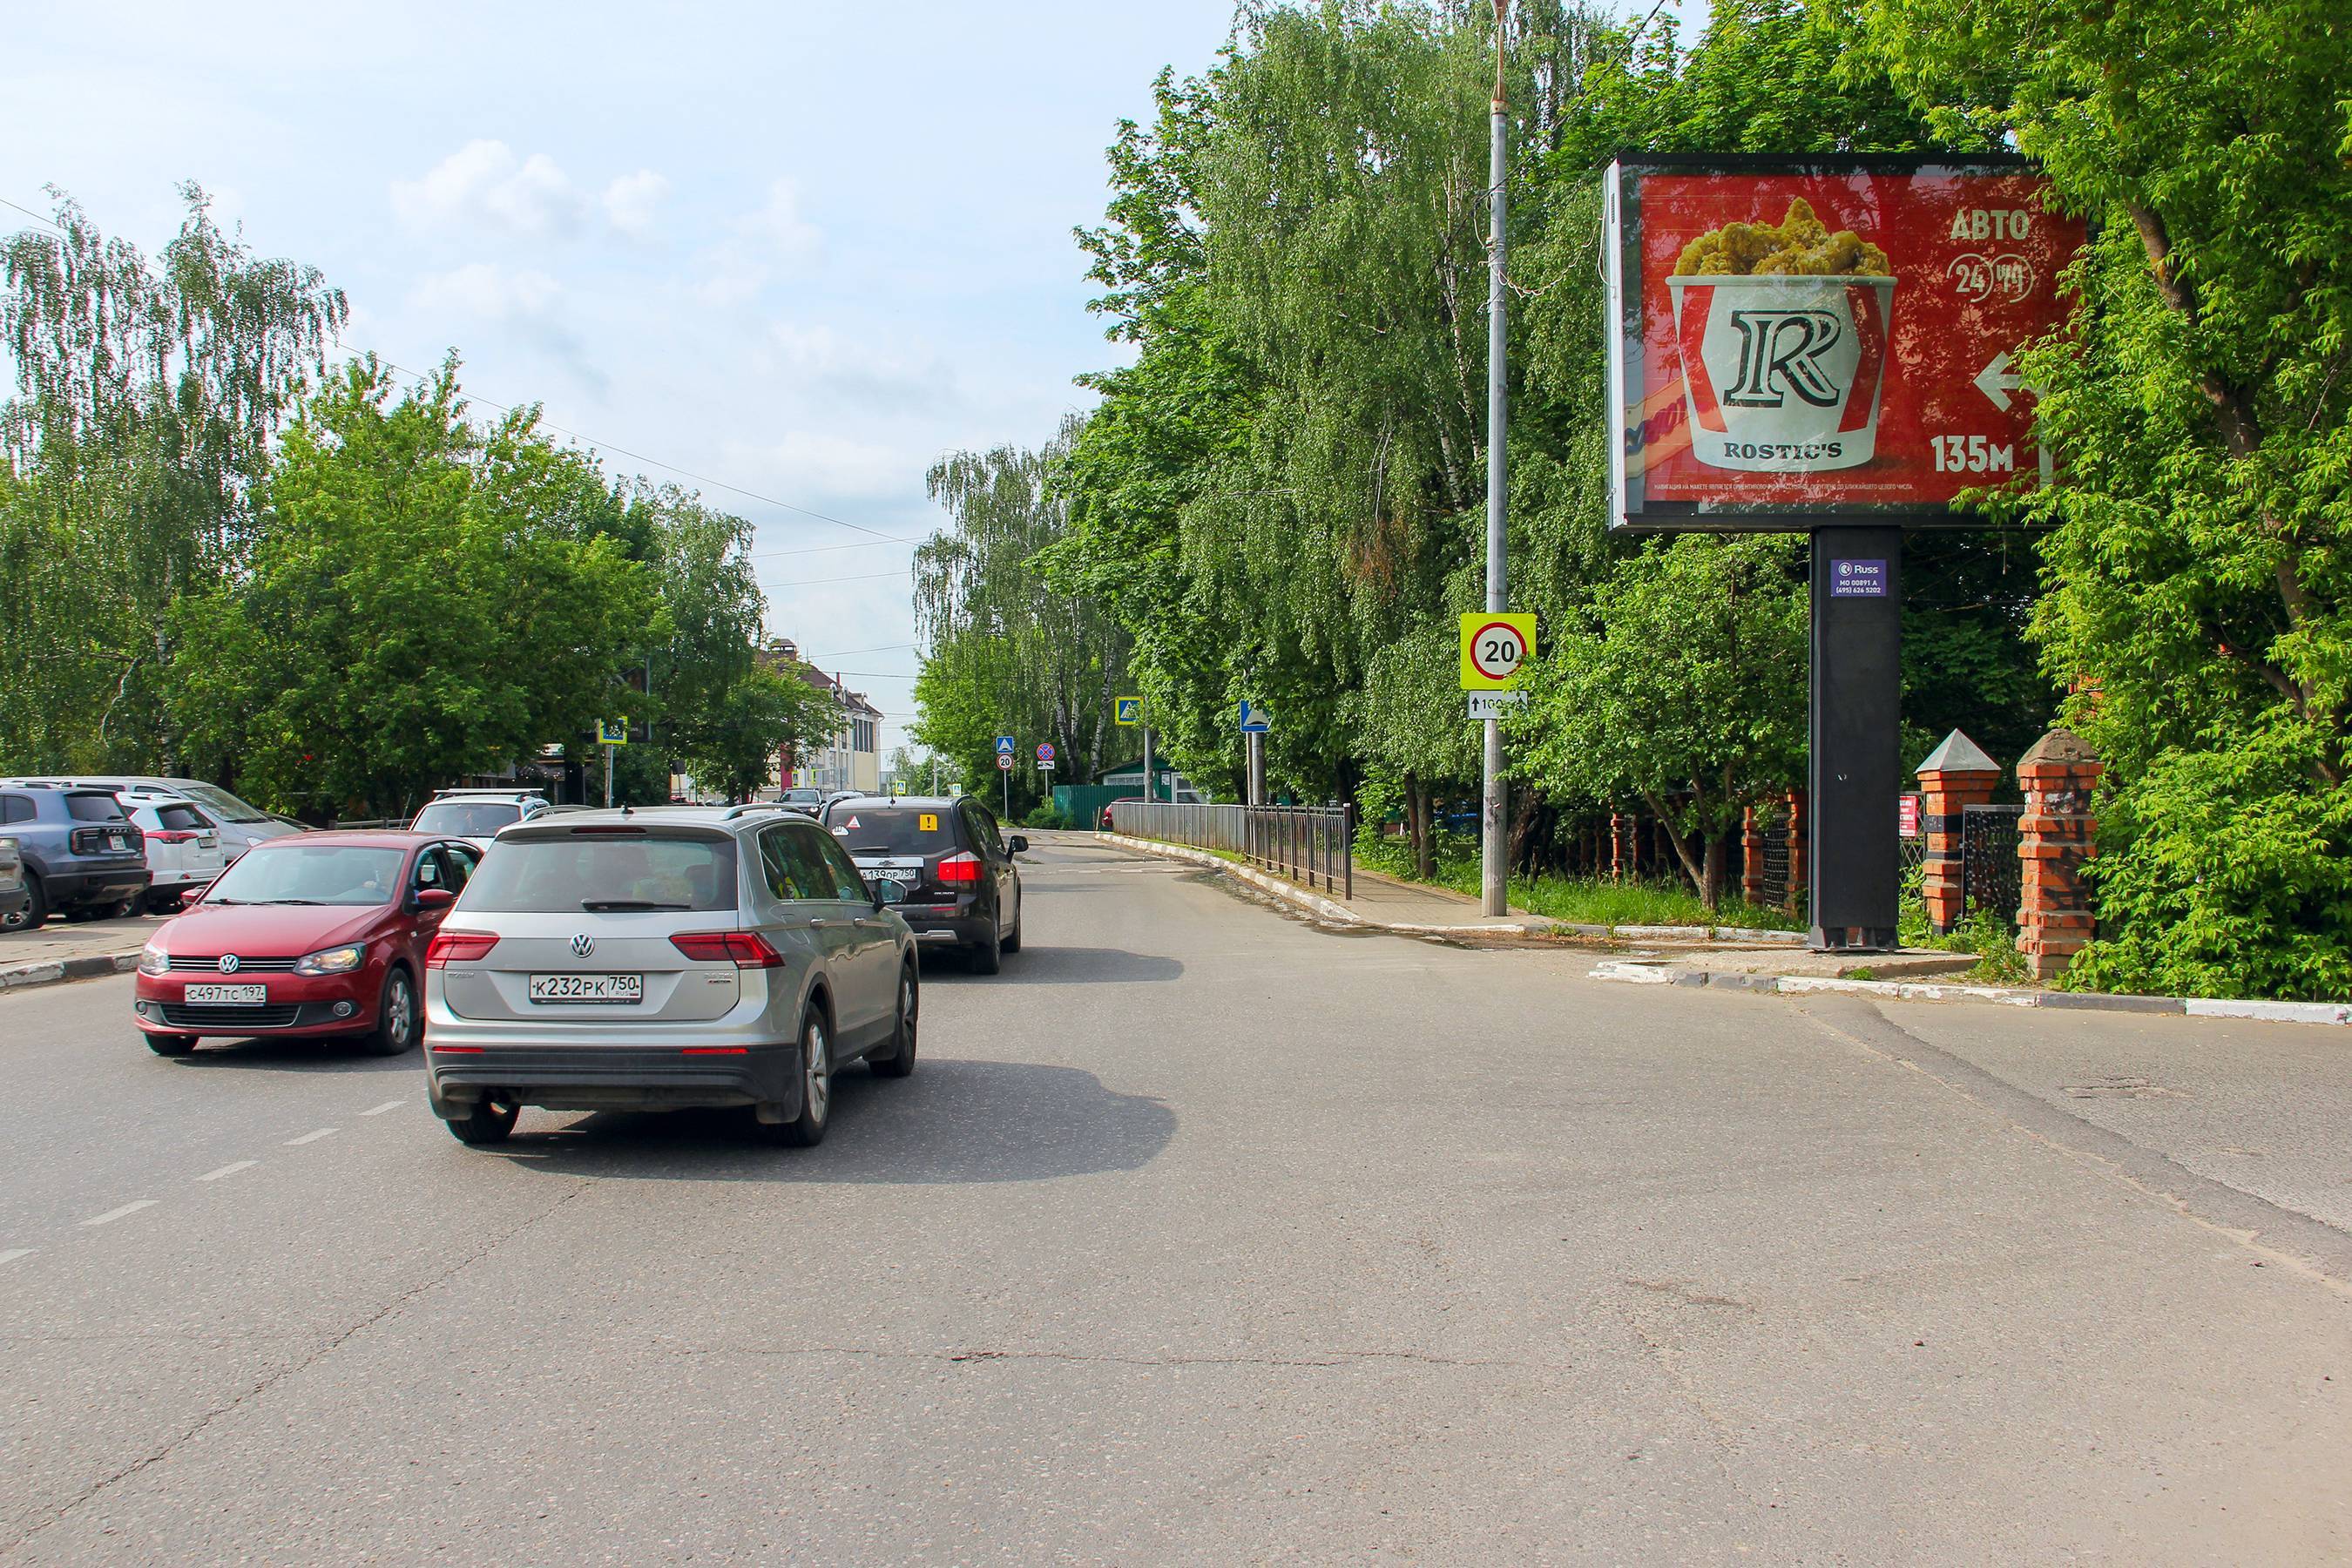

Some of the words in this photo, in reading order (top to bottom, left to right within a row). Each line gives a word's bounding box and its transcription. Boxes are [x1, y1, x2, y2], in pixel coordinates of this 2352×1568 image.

[1950, 209, 2030, 240] АВТО
[1956, 264, 1985, 293] 24
[1723, 443, 1842, 460] ROSTIC'S
[1854, 564, 1879, 574] Russ
[1484, 640, 1515, 662] 20
[242, 986, 261, 997] 197
[610, 977, 637, 990] 750
